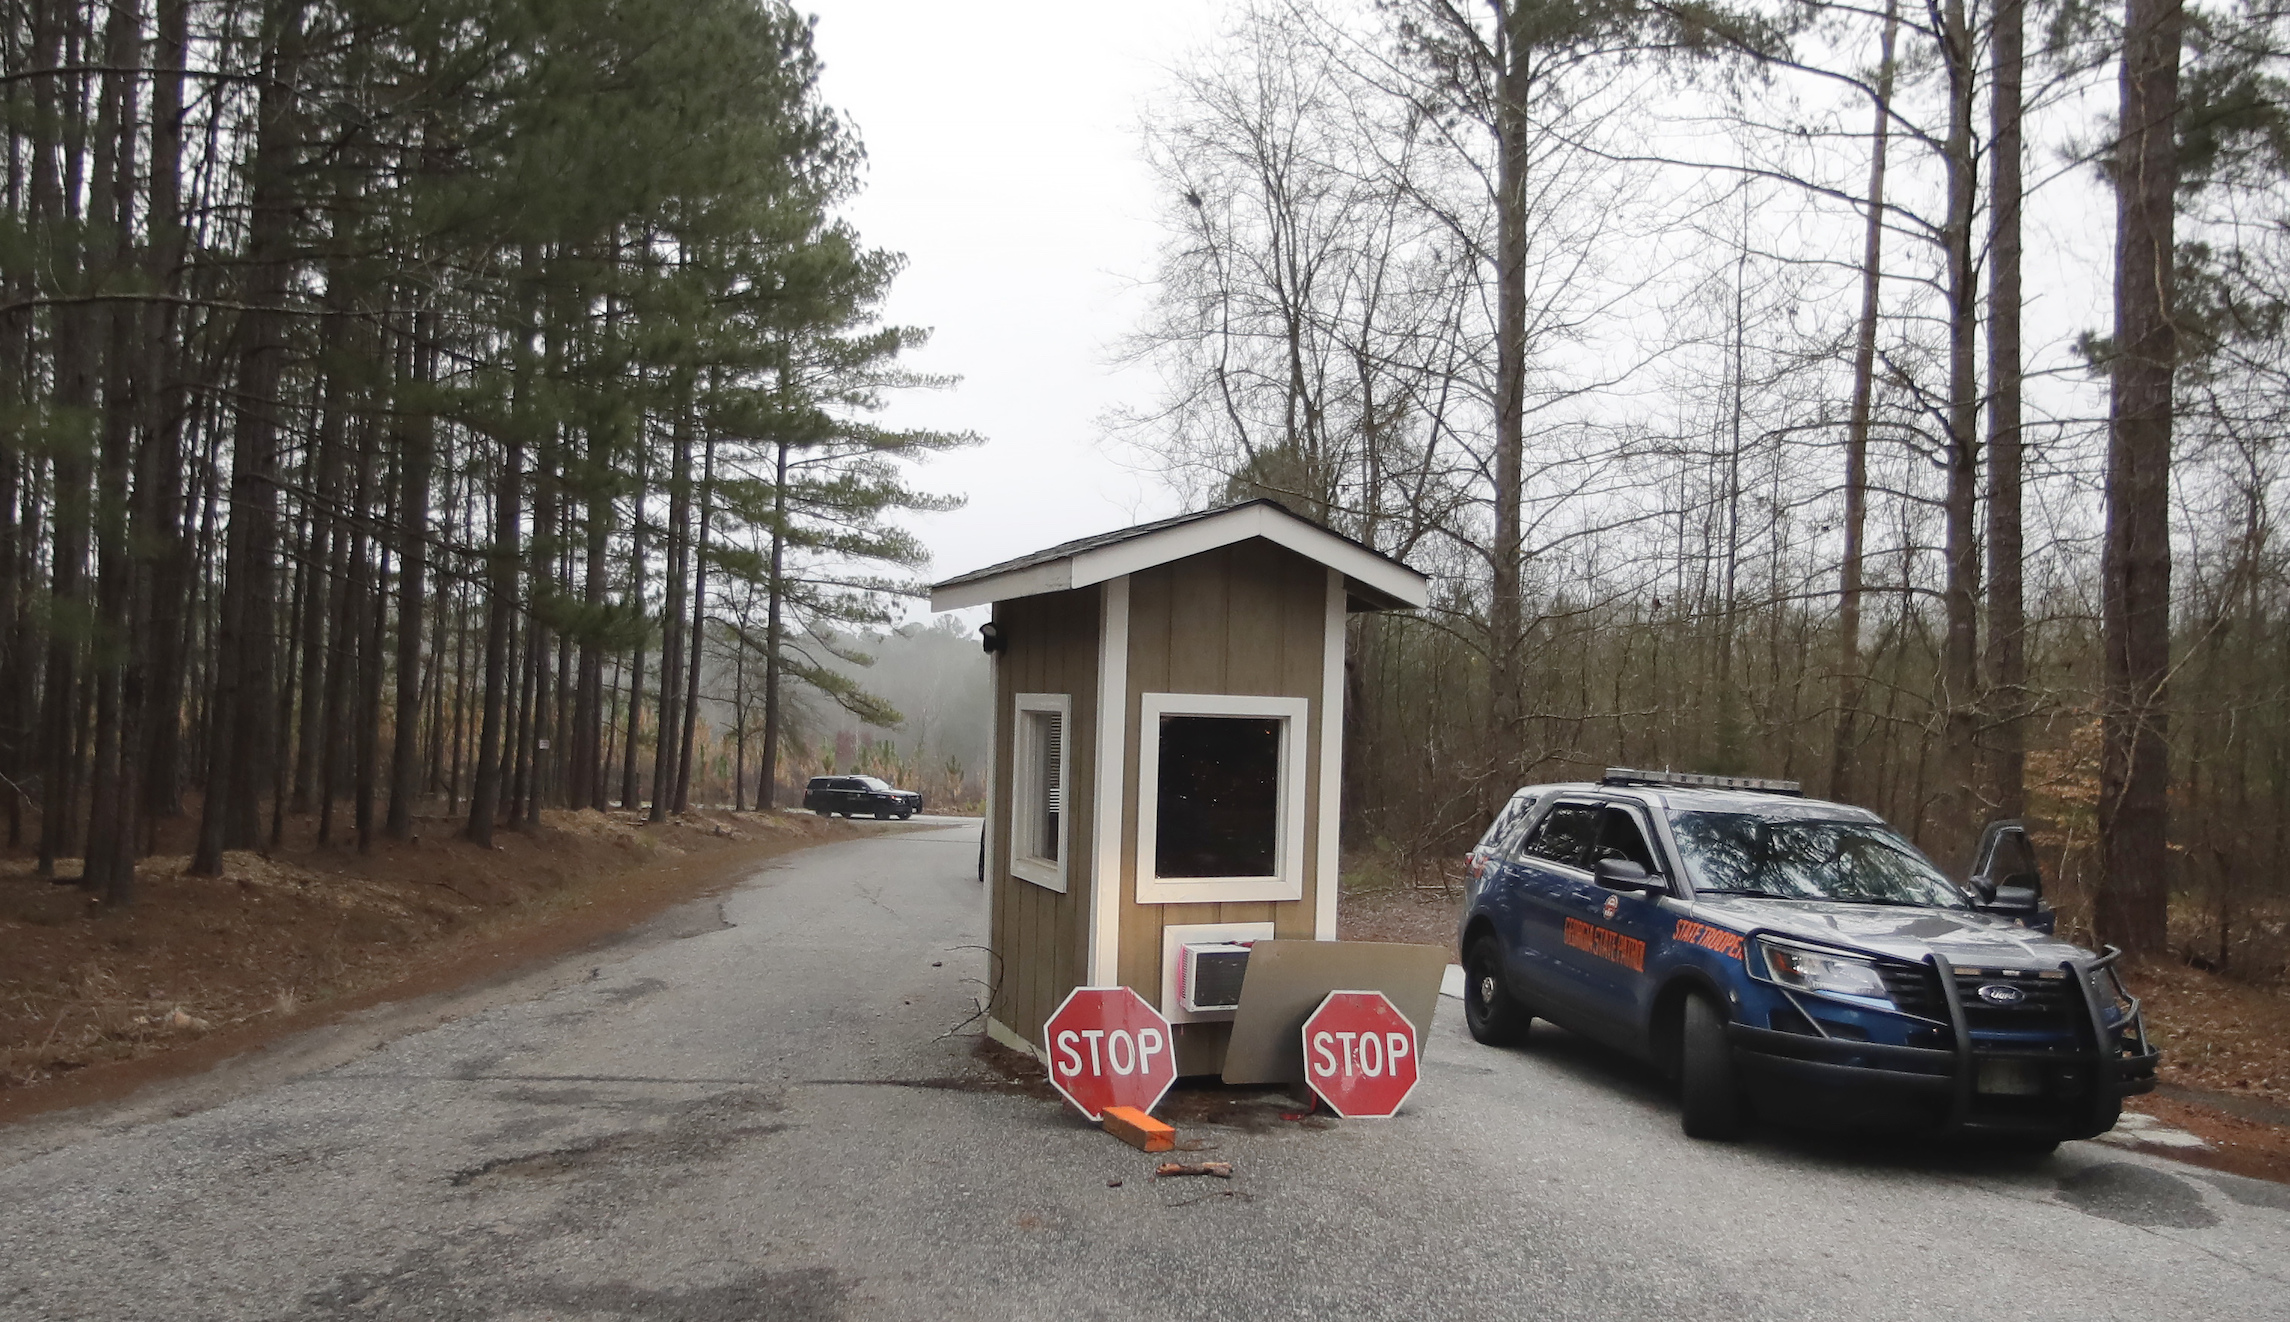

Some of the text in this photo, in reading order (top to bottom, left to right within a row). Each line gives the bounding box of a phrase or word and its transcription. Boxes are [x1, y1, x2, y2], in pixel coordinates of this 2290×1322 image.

[1593, 926, 1619, 963] STATE
[1617, 934, 1646, 973] PATROL
[1672, 918, 1745, 961] STATE TROOPER
[1990, 989, 2016, 1000] Ford
[1057, 1027, 1163, 1077] STOP
[1313, 1031, 1409, 1077] STOP
